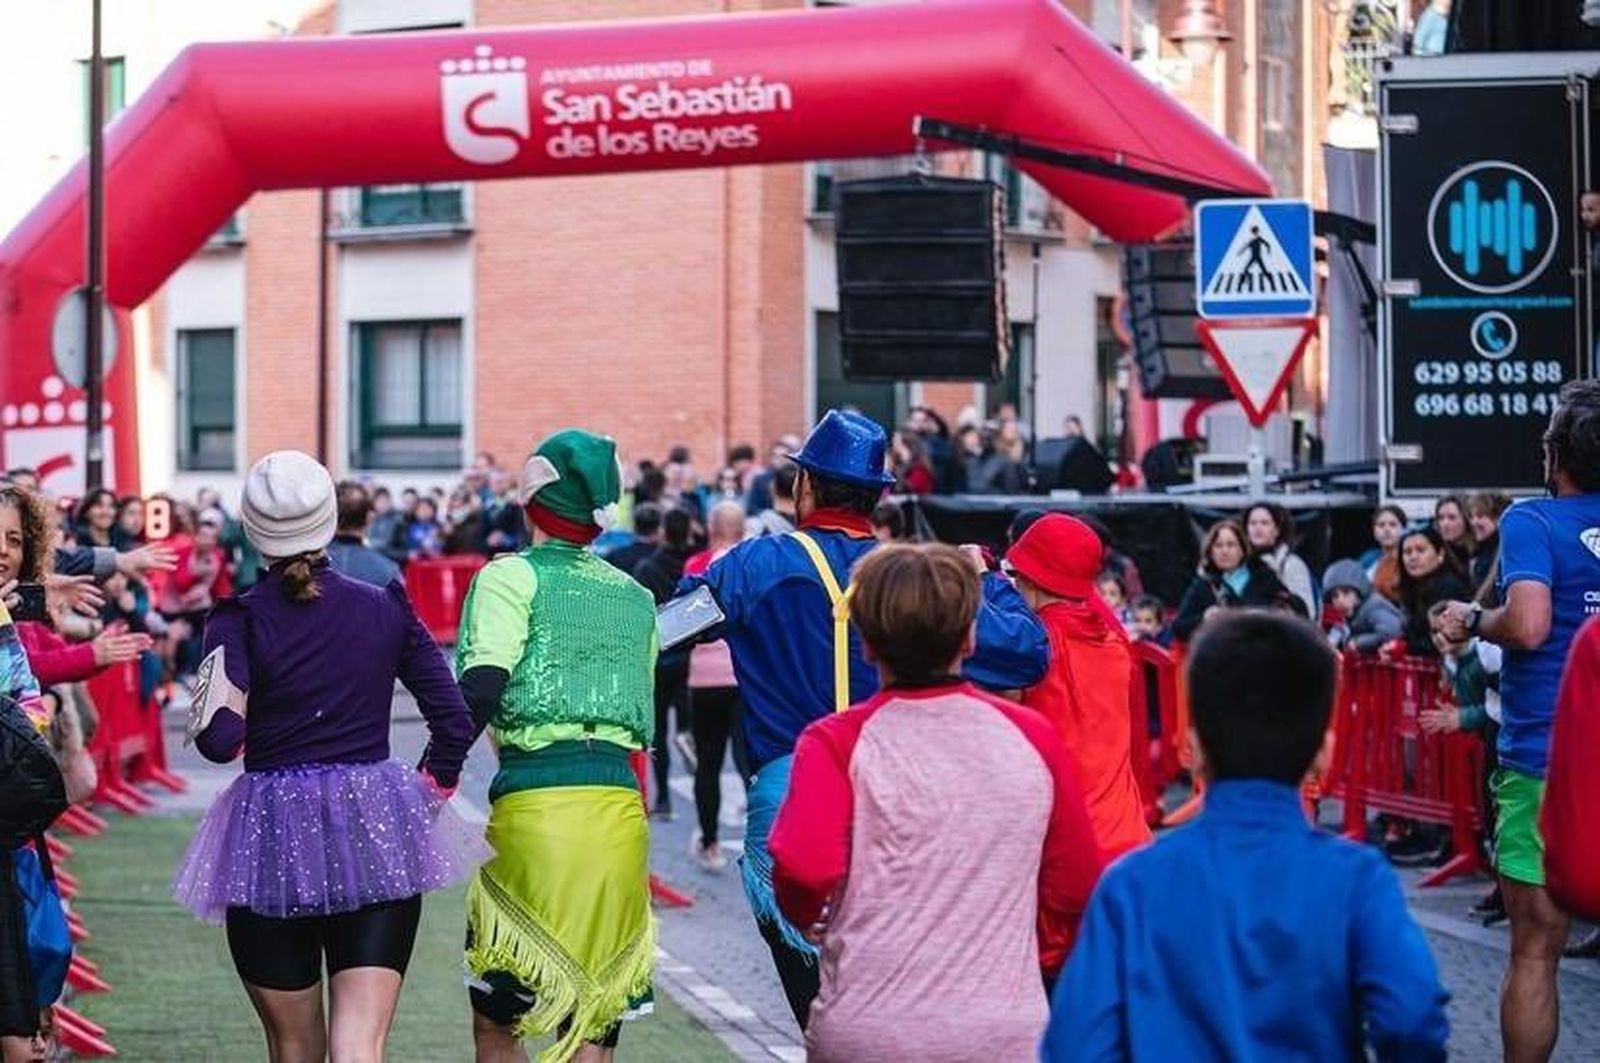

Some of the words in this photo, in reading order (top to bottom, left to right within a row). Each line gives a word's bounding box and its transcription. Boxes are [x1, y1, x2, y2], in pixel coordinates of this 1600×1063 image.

[541, 60, 684, 84] AYUNTAMIENTO
[687, 59, 712, 76] DE
[542, 88, 612, 124] San
[617, 75, 792, 121] Sebastián
[546, 127, 596, 158] de
[599, 125, 648, 155] los
[653, 122, 759, 156] Reyes
[1414, 361, 1460, 385] 629
[1463, 361, 1494, 384] 95
[1497, 361, 1528, 384] 05
[1531, 361, 1562, 384] 88
[1414, 393, 1460, 416] 696
[1463, 393, 1495, 416] 68
[1499, 393, 1529, 416] 18
